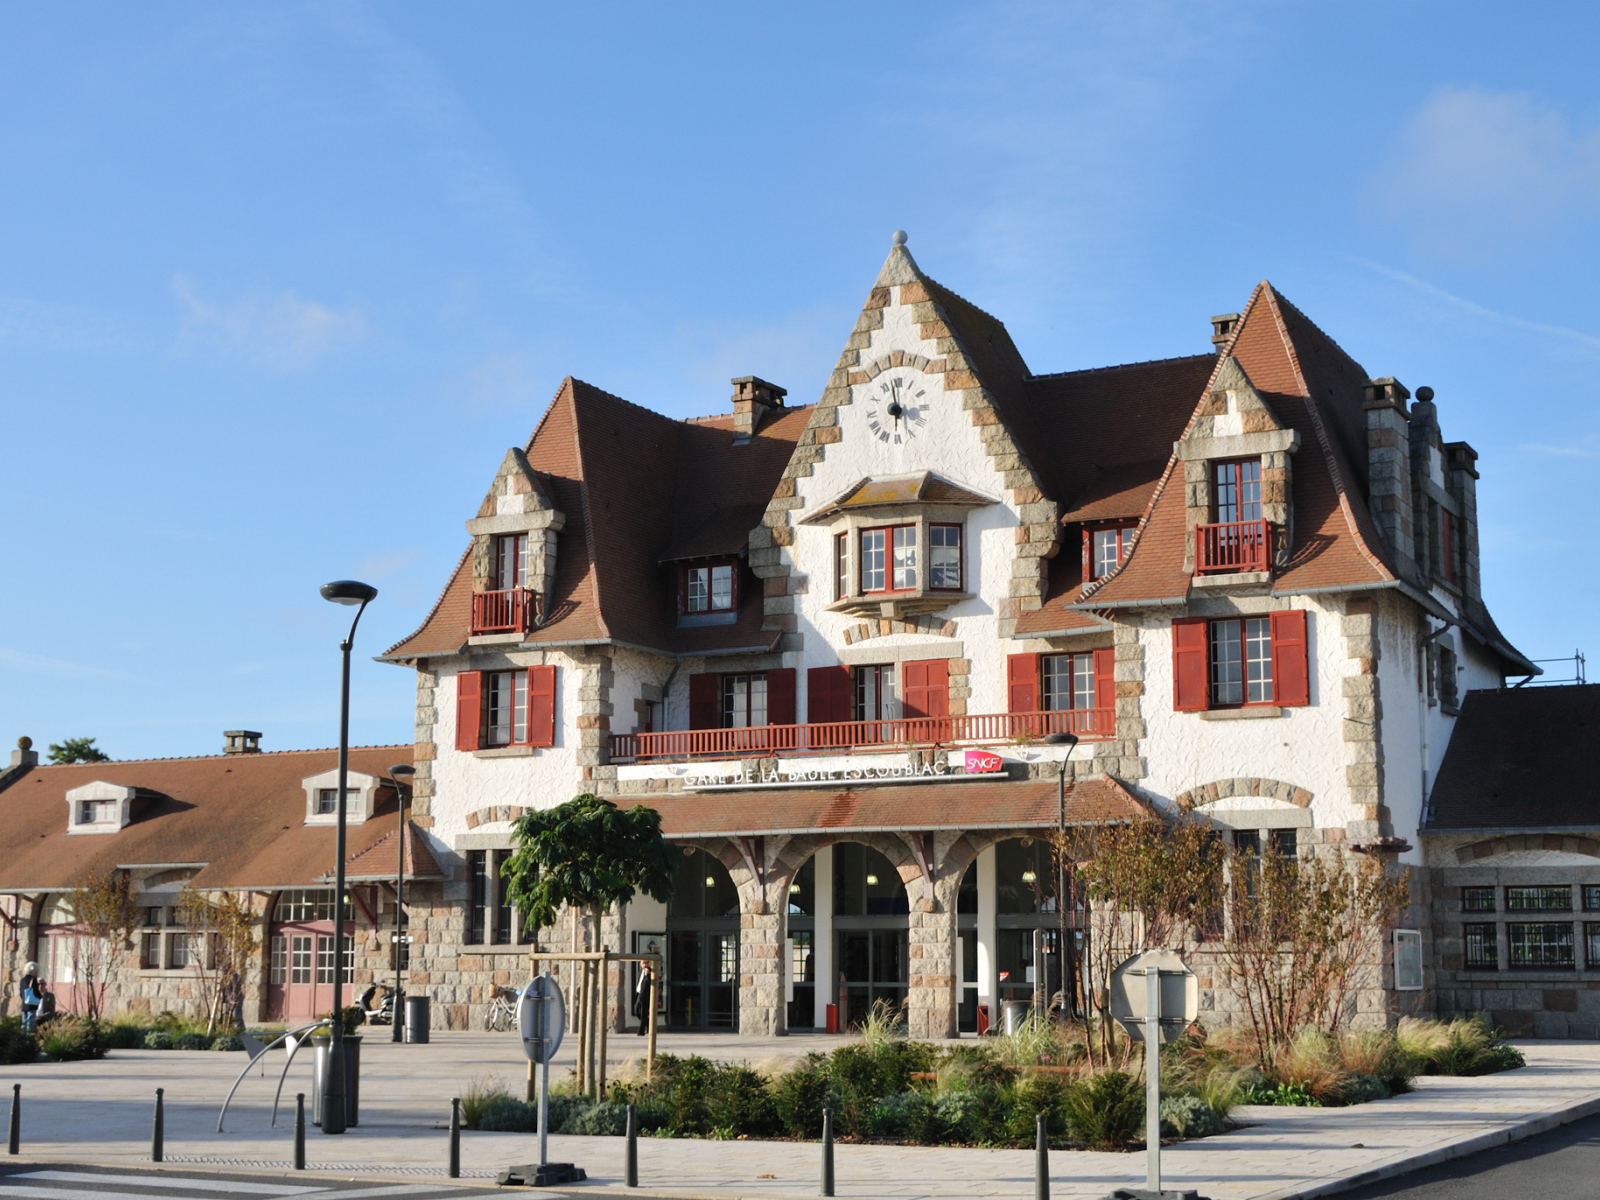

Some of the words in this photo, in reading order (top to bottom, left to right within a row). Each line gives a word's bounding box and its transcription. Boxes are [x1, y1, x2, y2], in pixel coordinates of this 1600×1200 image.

[880, 382, 890, 394] XI
[907, 380, 914, 390] I
[915, 389, 926, 398] II
[870, 395, 881, 405] X
[894, 433, 902, 444] VI
[908, 429, 916, 440] V
[966, 757, 1000, 770] SNCF
[683, 773, 727, 785] GARE
[734, 769, 753, 784] DE
[761, 768, 779, 783] LA
[788, 766, 835, 781] BAULE
[843, 761, 945, 779] ESCOUBLAC
